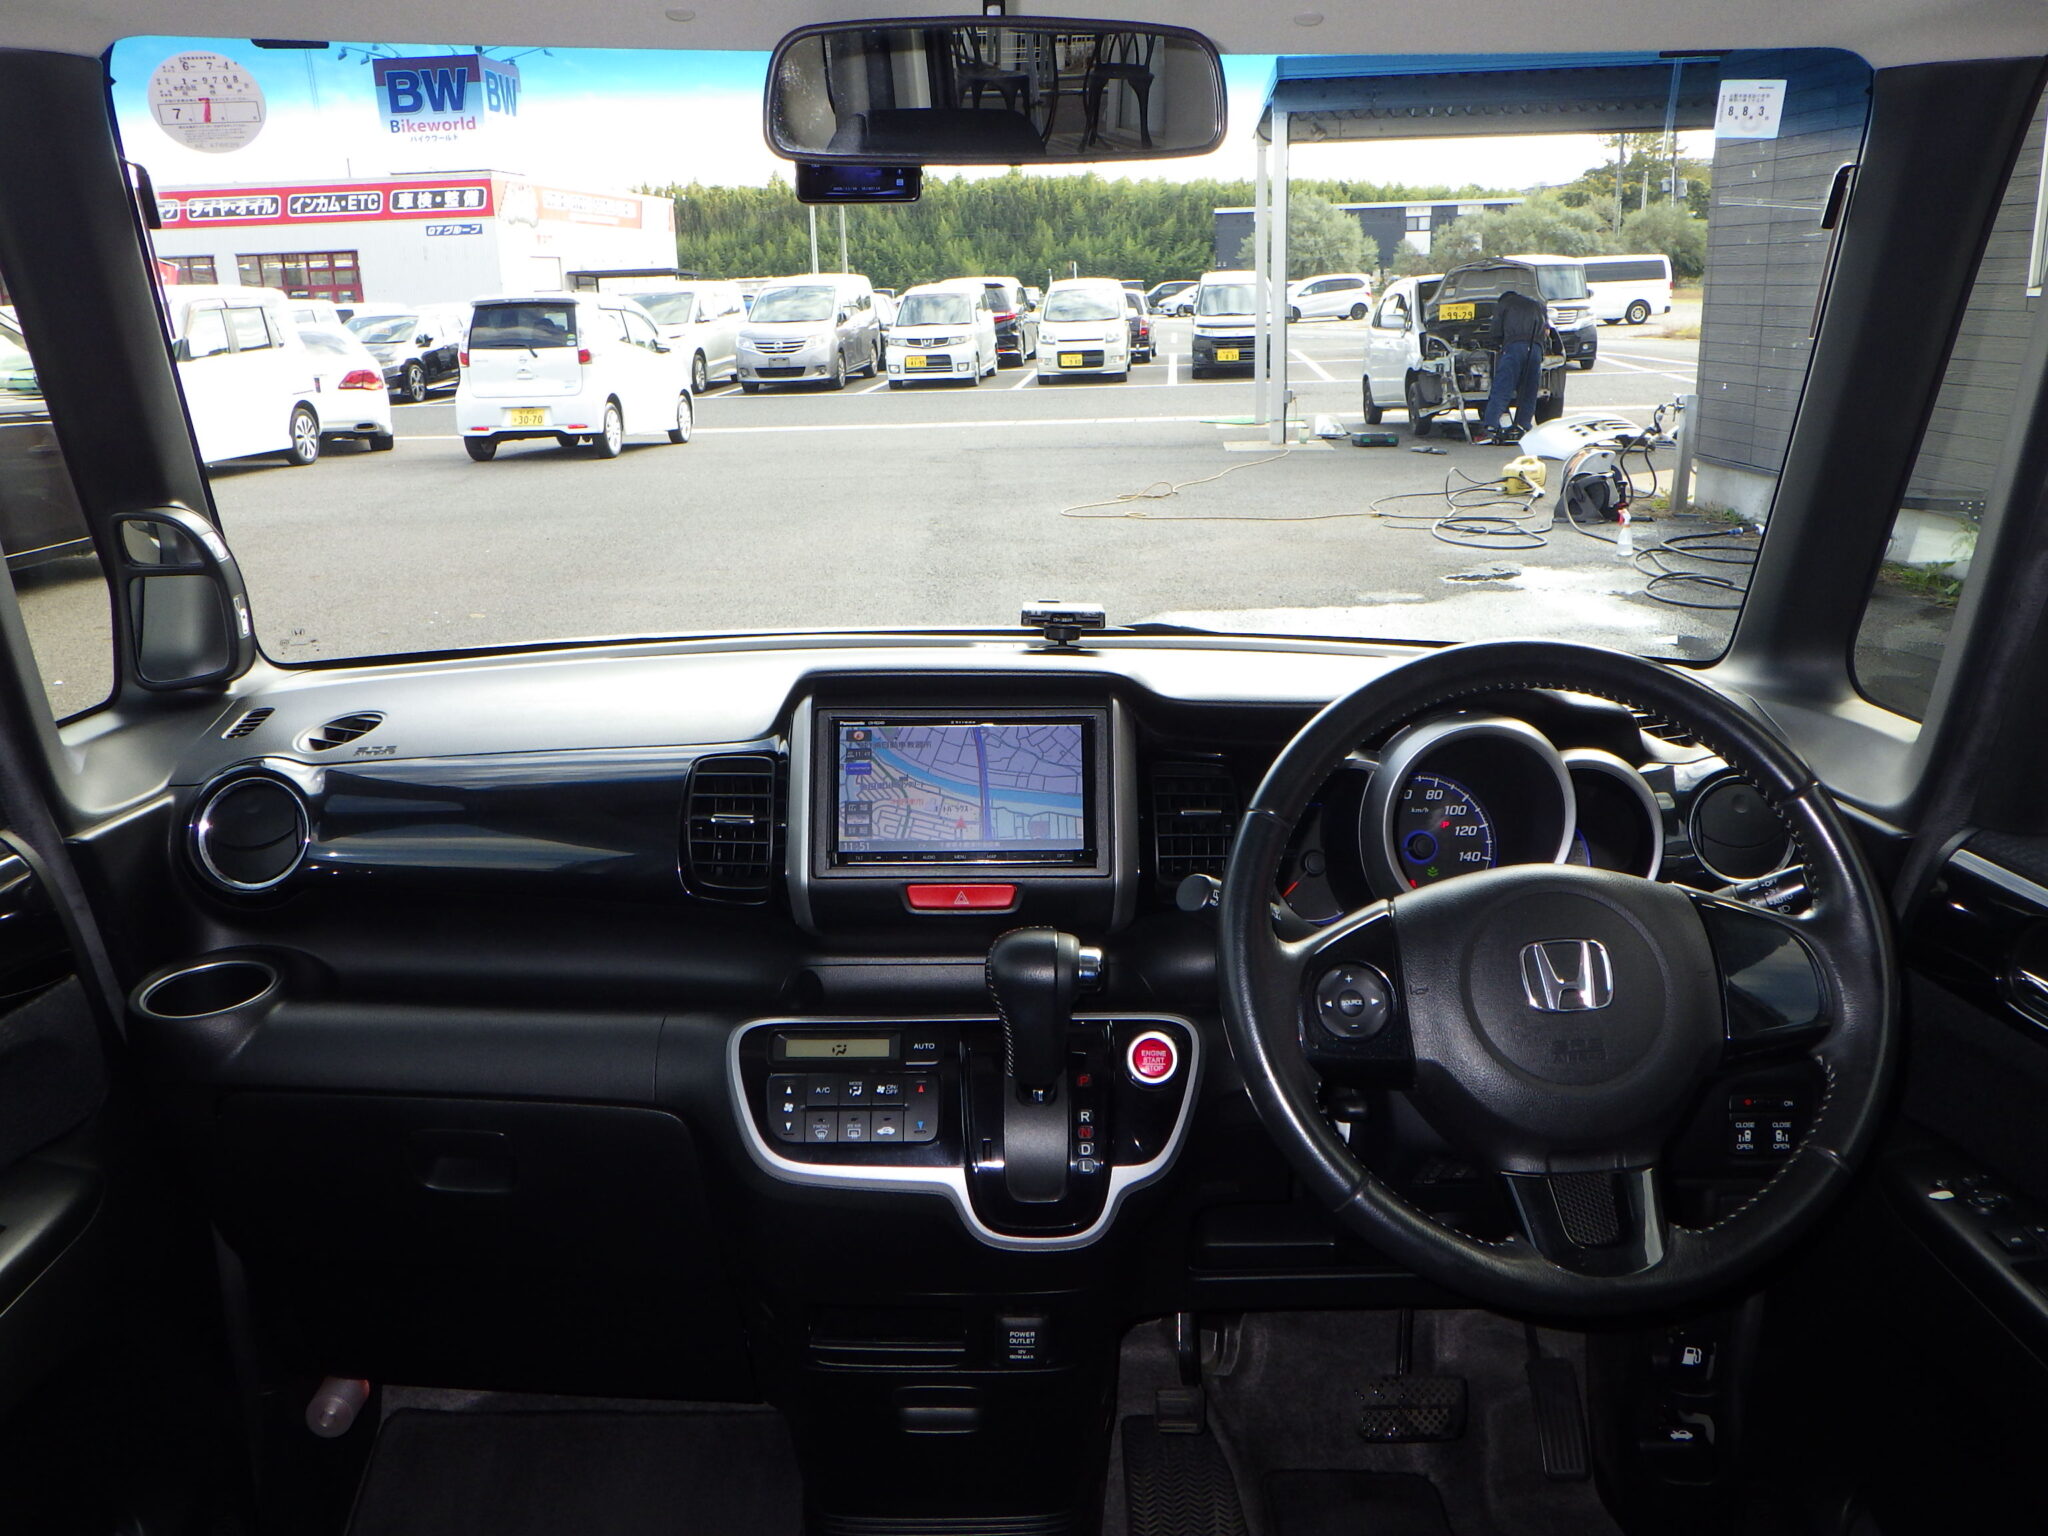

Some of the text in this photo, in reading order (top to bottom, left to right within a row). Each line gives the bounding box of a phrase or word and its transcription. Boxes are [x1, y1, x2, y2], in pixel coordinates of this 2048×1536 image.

[385, 68, 467, 114] BW
[484, 70, 517, 116] BW
[390, 117, 476, 133] Bikeworld
[1425, 789, 1443, 800] 80
[1444, 805, 1467, 815] 100
[1455, 826, 1477, 836] 120
[843, 842, 870, 851] 11:51
[1459, 851, 1481, 862] 140
[913, 1042, 935, 1050] AUTO
[1080, 1111, 1090, 1122] R
[1081, 1144, 1091, 1155] D
[1082, 1161, 1090, 1172] L
